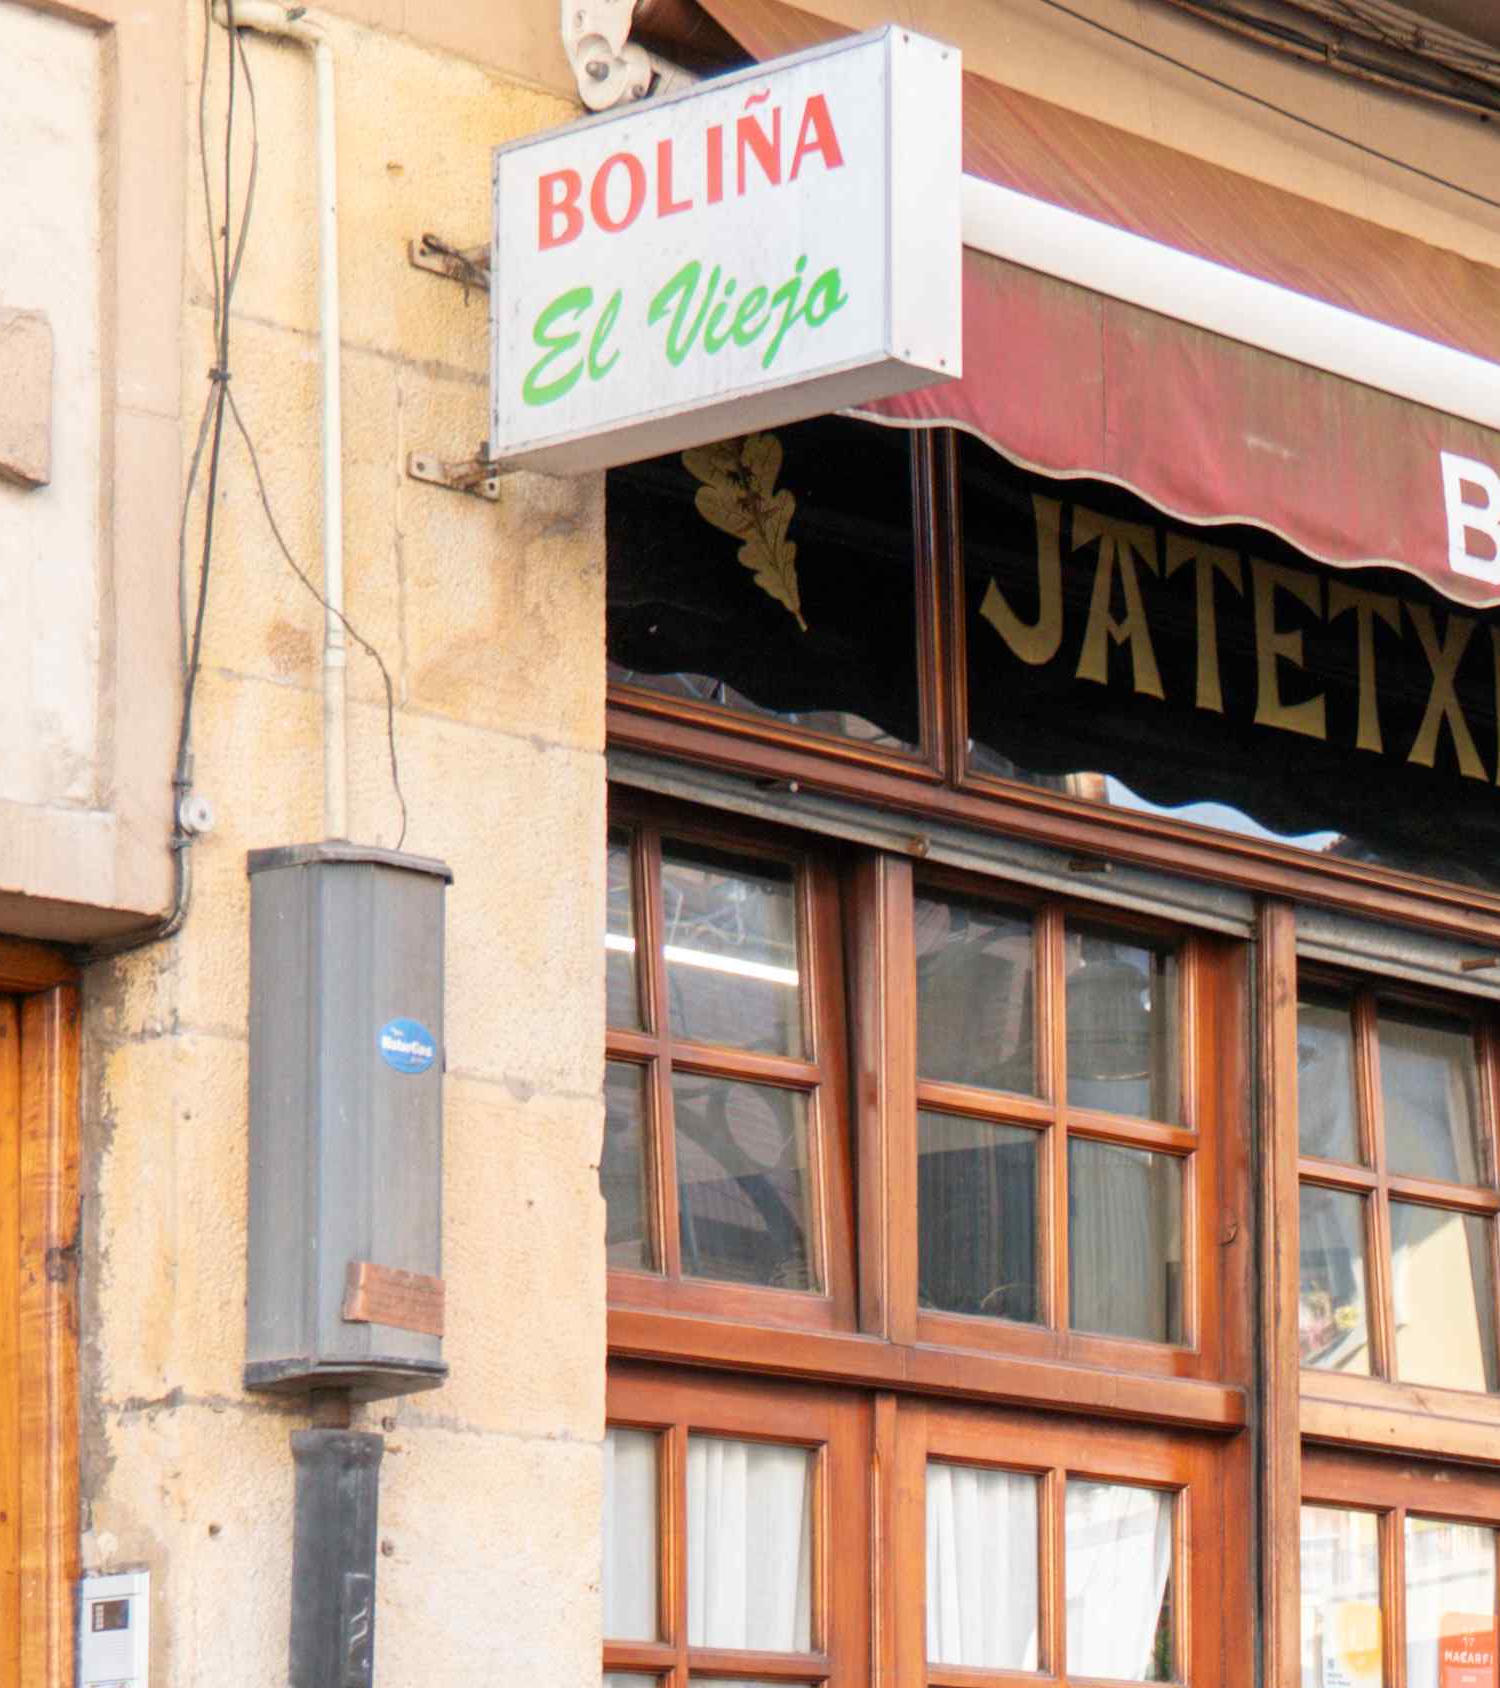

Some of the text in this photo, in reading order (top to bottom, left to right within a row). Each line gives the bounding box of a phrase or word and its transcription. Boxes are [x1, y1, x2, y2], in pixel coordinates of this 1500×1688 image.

[538, 88, 845, 252] BOLIÑA
[522, 253, 848, 406] El Viejo
